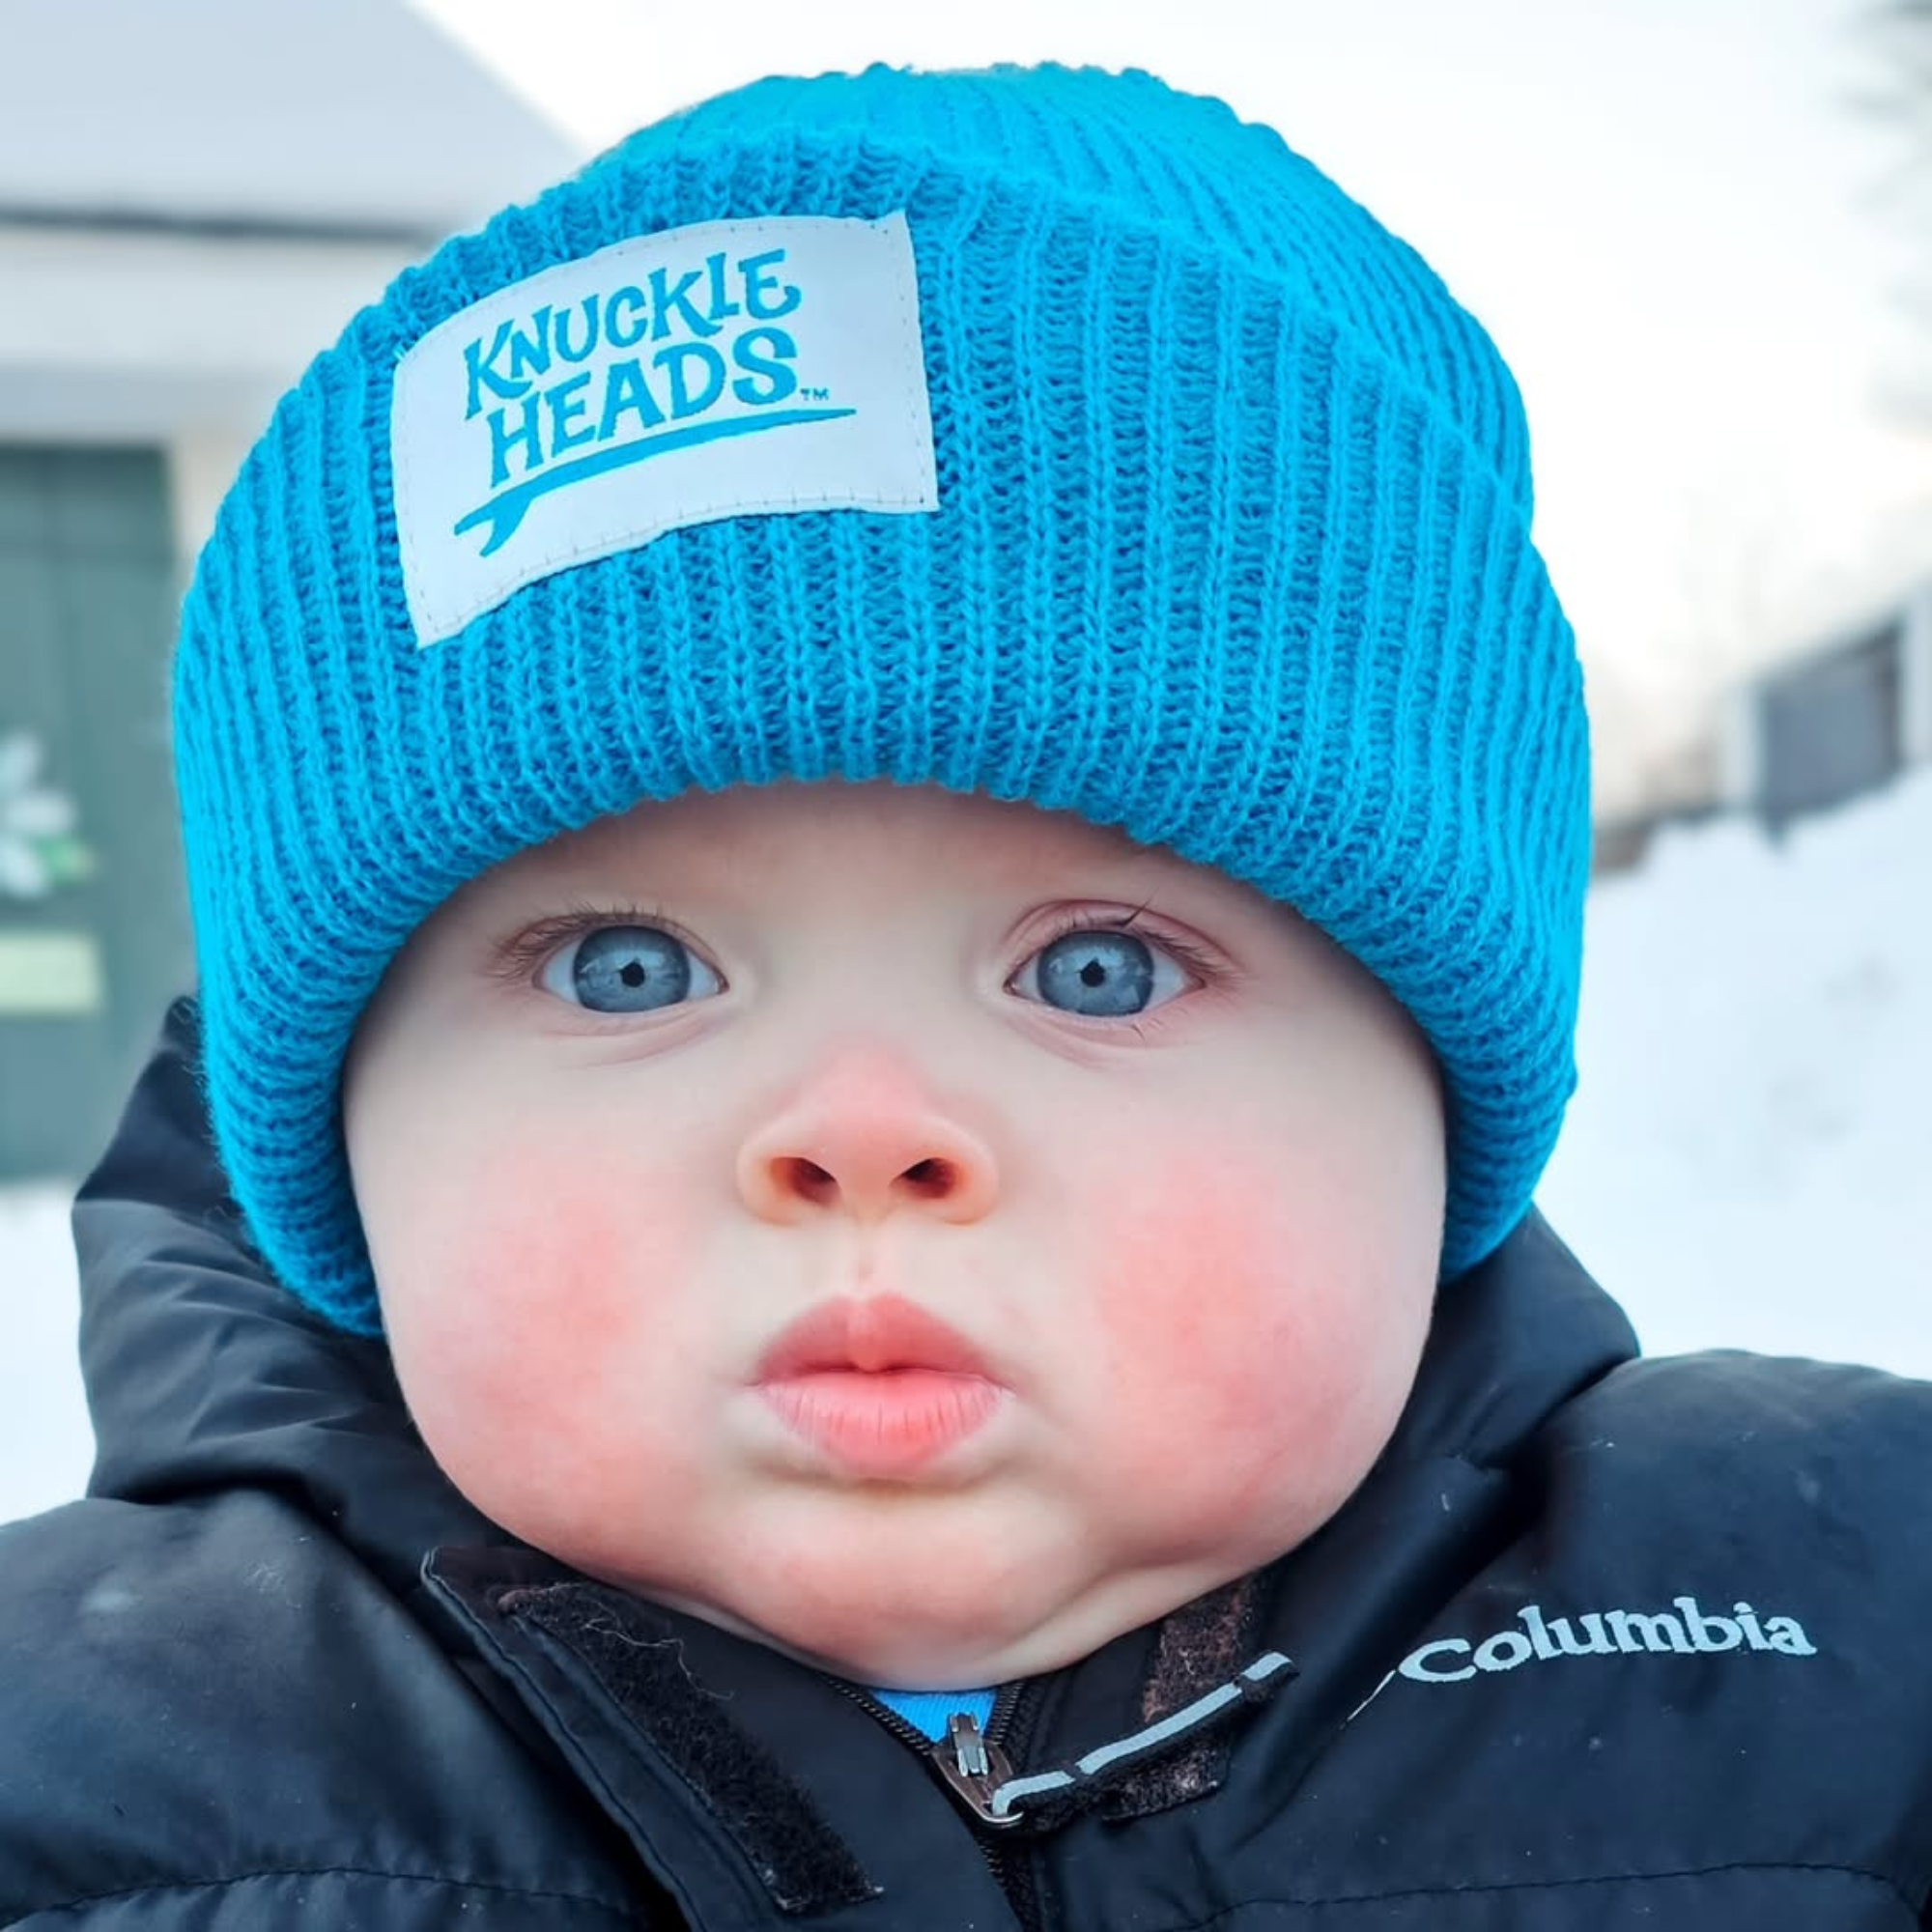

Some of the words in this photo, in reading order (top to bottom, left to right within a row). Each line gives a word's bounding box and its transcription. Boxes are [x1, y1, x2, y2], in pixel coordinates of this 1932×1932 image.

[464, 248, 801, 420] KNUCKLE
[486, 327, 799, 488] HEADS
[1398, 1596, 1818, 1683] Columbia
